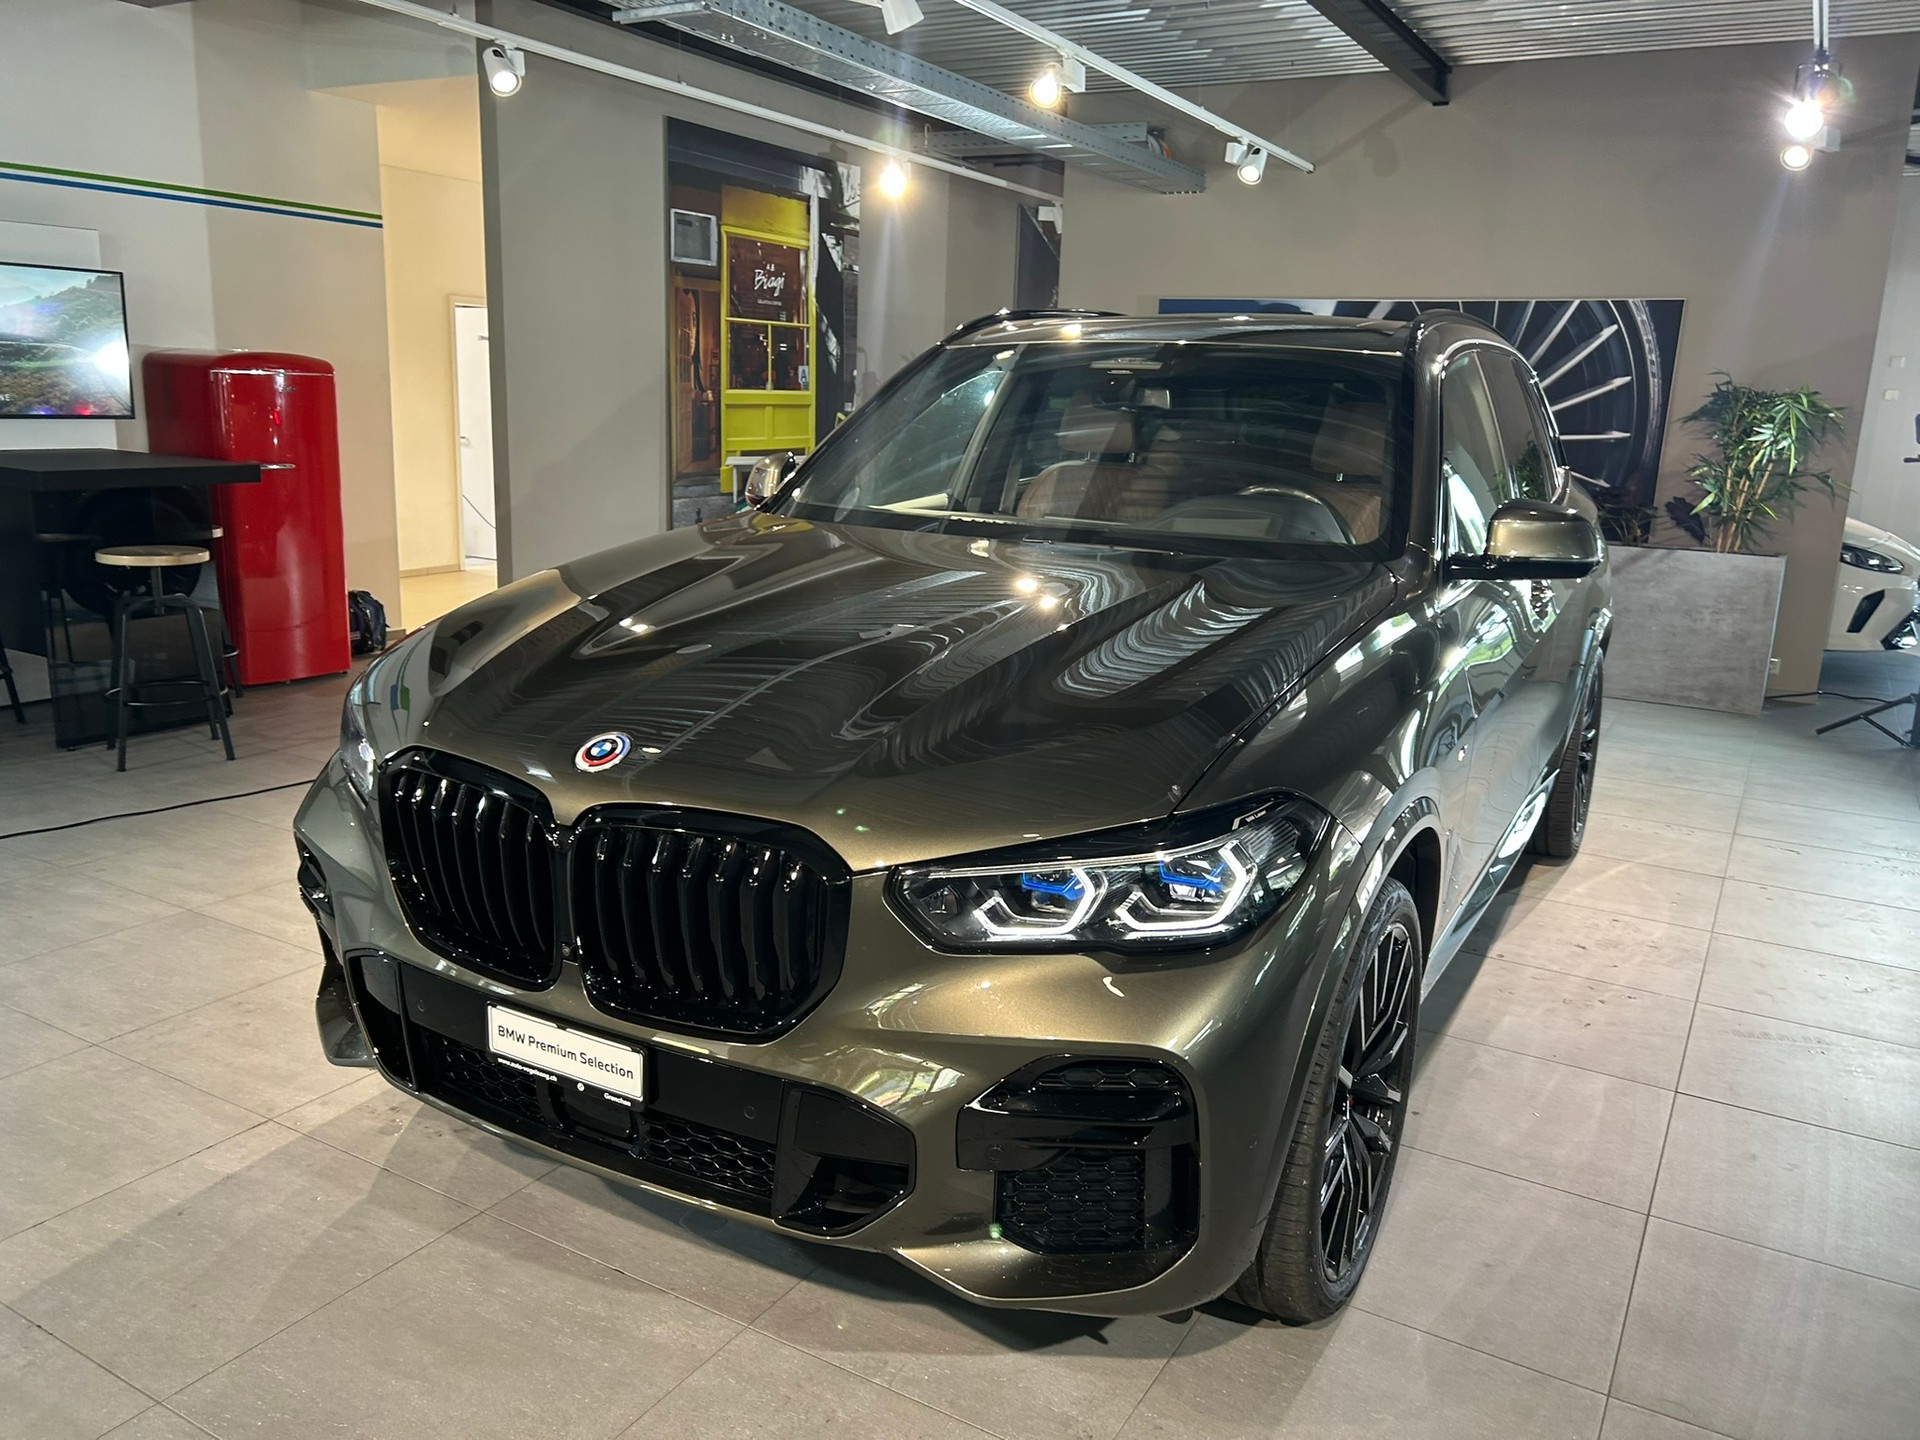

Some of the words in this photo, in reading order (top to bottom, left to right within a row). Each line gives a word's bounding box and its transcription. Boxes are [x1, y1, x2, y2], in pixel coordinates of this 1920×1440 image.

[754, 269, 786, 297] Biagi
[498, 1025, 525, 1044] BMW
[528, 1036, 577, 1061] Premium
[580, 1052, 634, 1079] Selection
